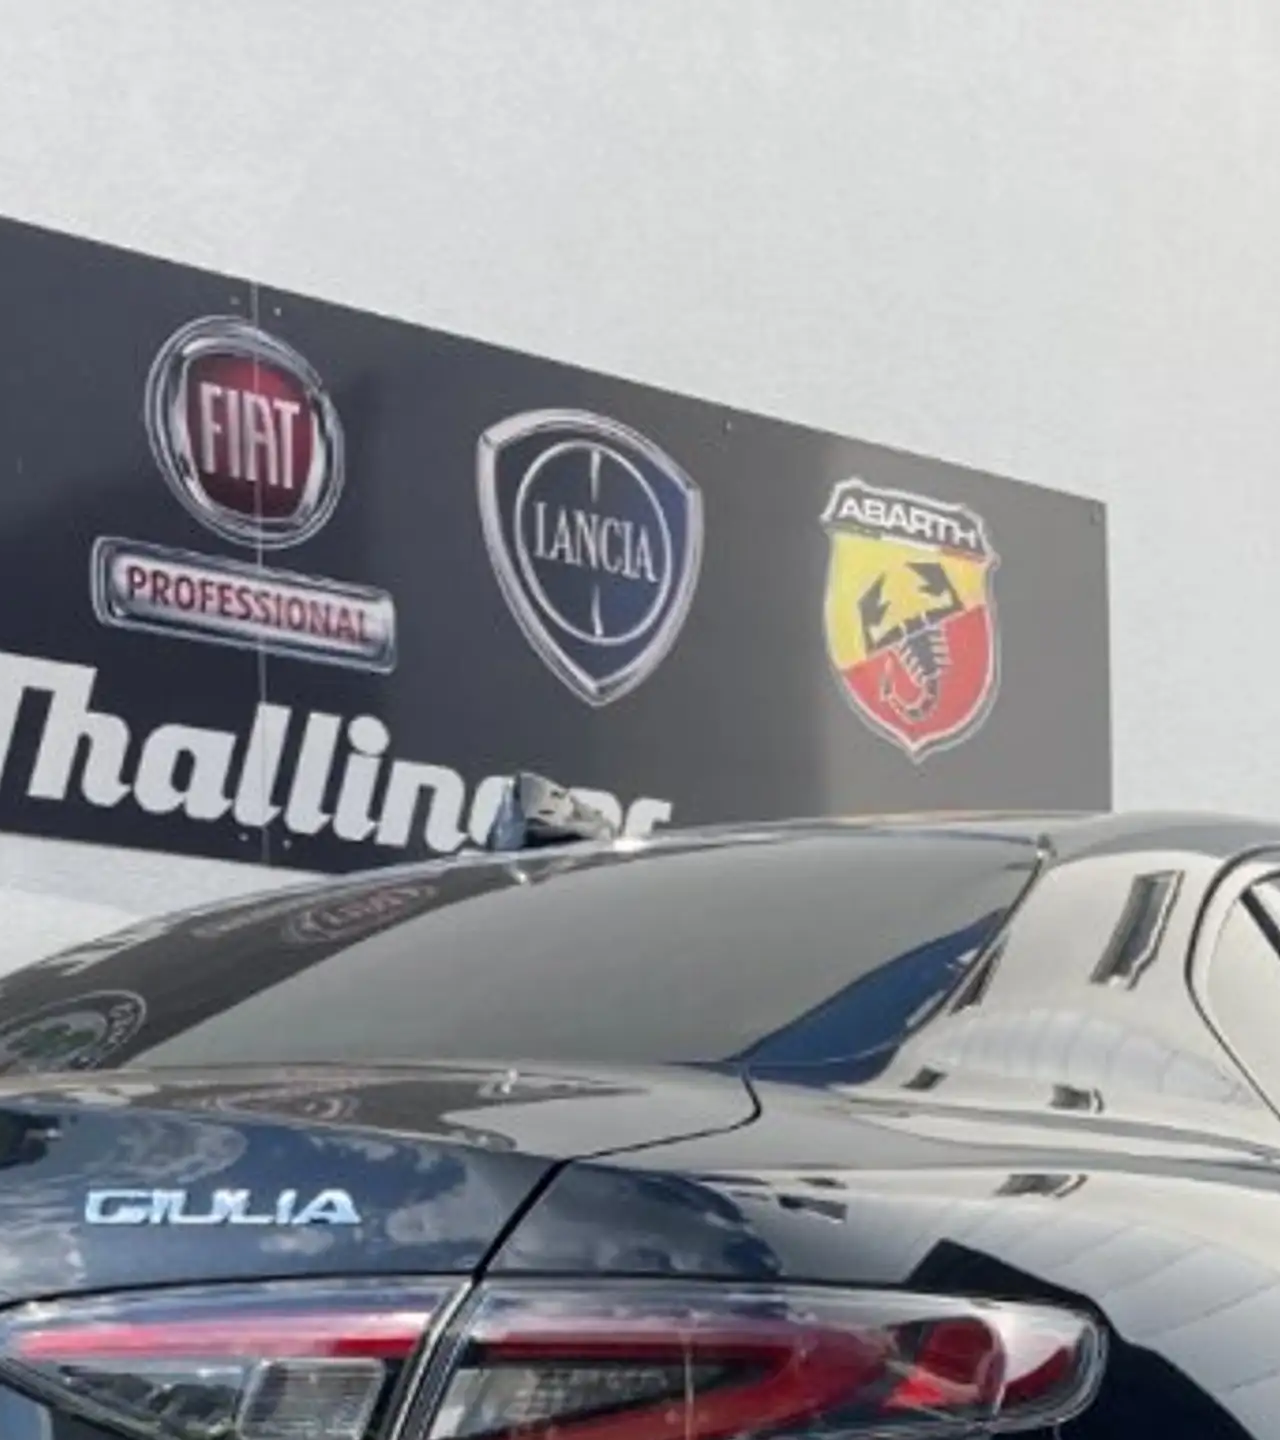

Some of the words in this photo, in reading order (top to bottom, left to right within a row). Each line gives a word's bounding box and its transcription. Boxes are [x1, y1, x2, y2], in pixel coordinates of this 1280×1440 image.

[200, 380, 300, 489] FIAT
[532, 501, 659, 584] LANCIA
[837, 498, 977, 549] ABARTH
[126, 565, 372, 644] PROFESSIONAL
[84, 1188, 362, 1224] GIULIA
